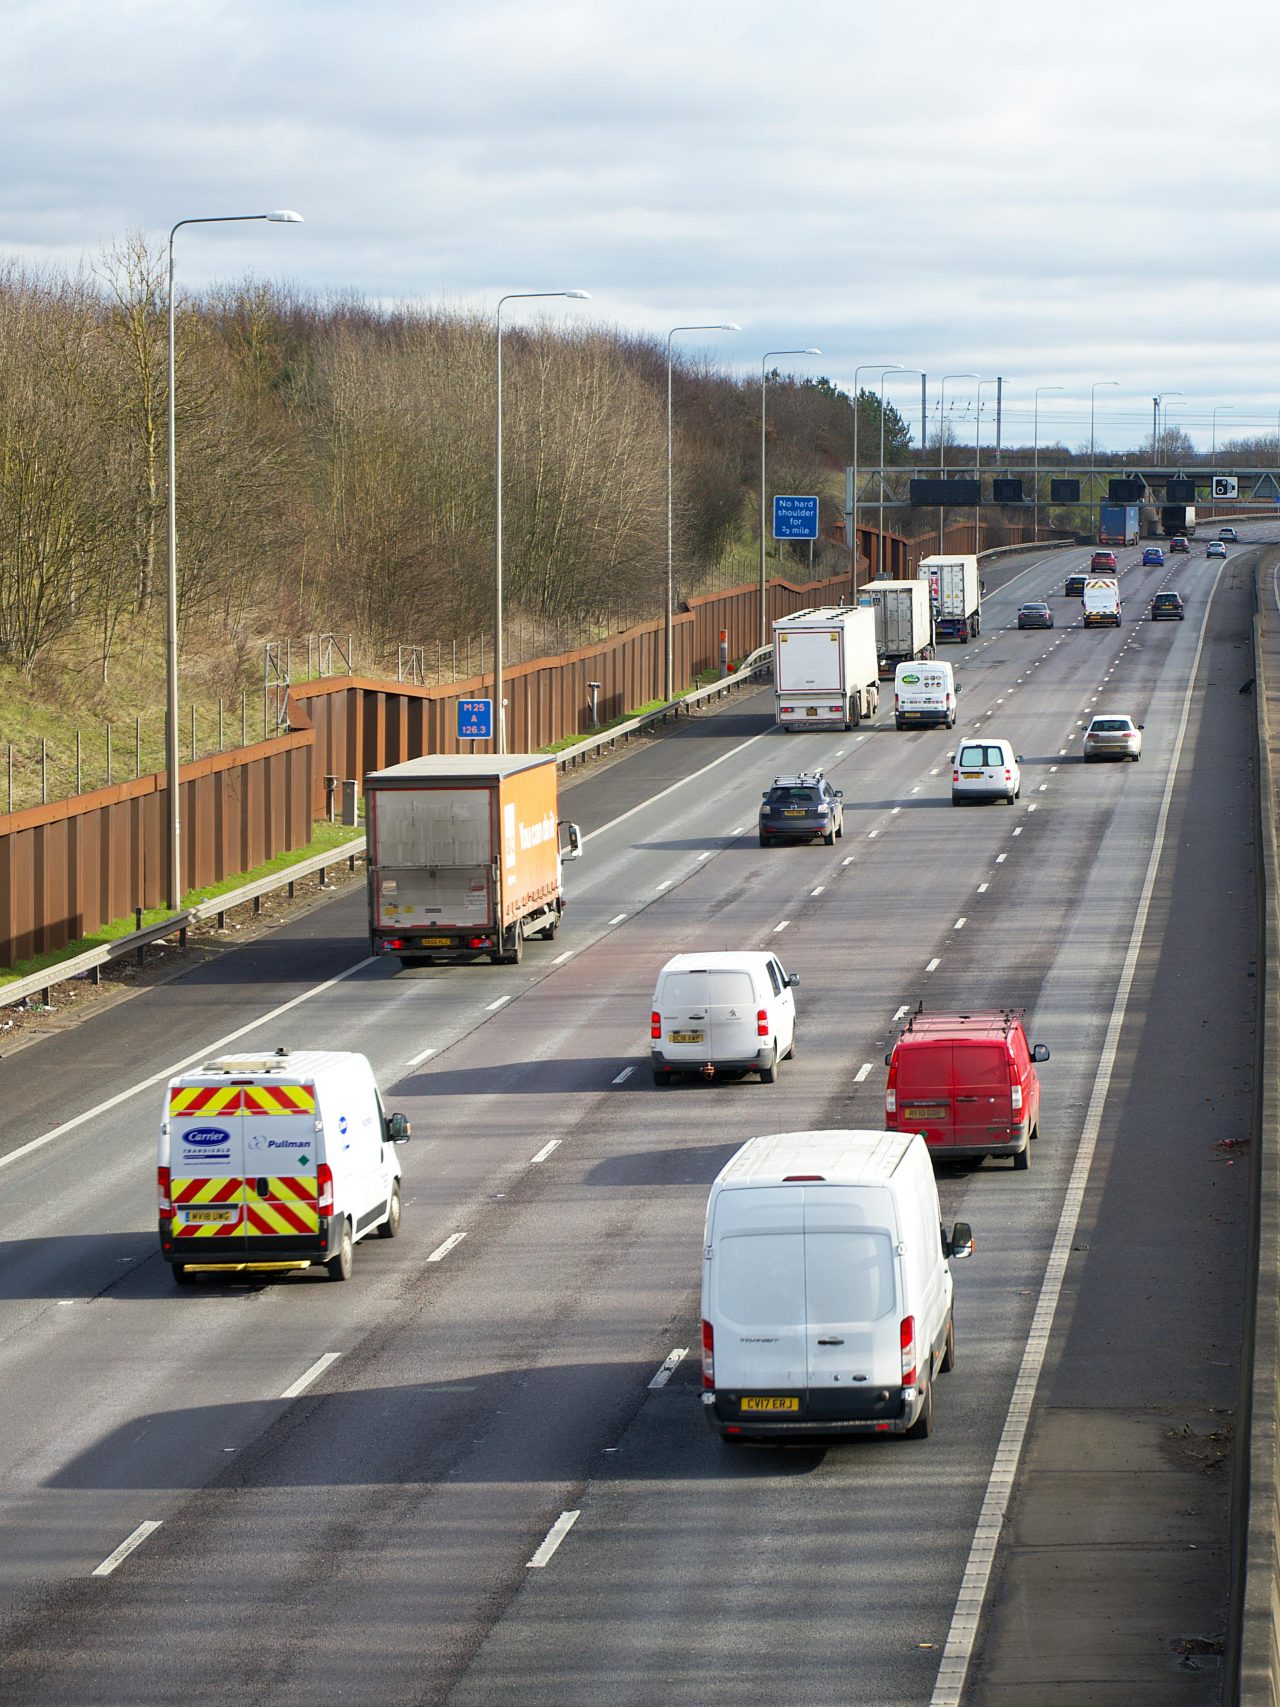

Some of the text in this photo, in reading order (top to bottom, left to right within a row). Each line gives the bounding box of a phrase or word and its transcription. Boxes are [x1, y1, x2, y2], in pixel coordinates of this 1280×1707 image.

[795, 500, 814, 508] hard
[778, 509, 814, 517] shoulder
[790, 517, 802, 526] for
[792, 526, 810, 535] mile
[471, 714, 478, 723] A
[462, 725, 487, 734] 126.3
[188, 1131, 225, 1141] Carrier
[267, 1140, 311, 1149] Pullman
[747, 1399, 793, 1409] CV17 ERJ
